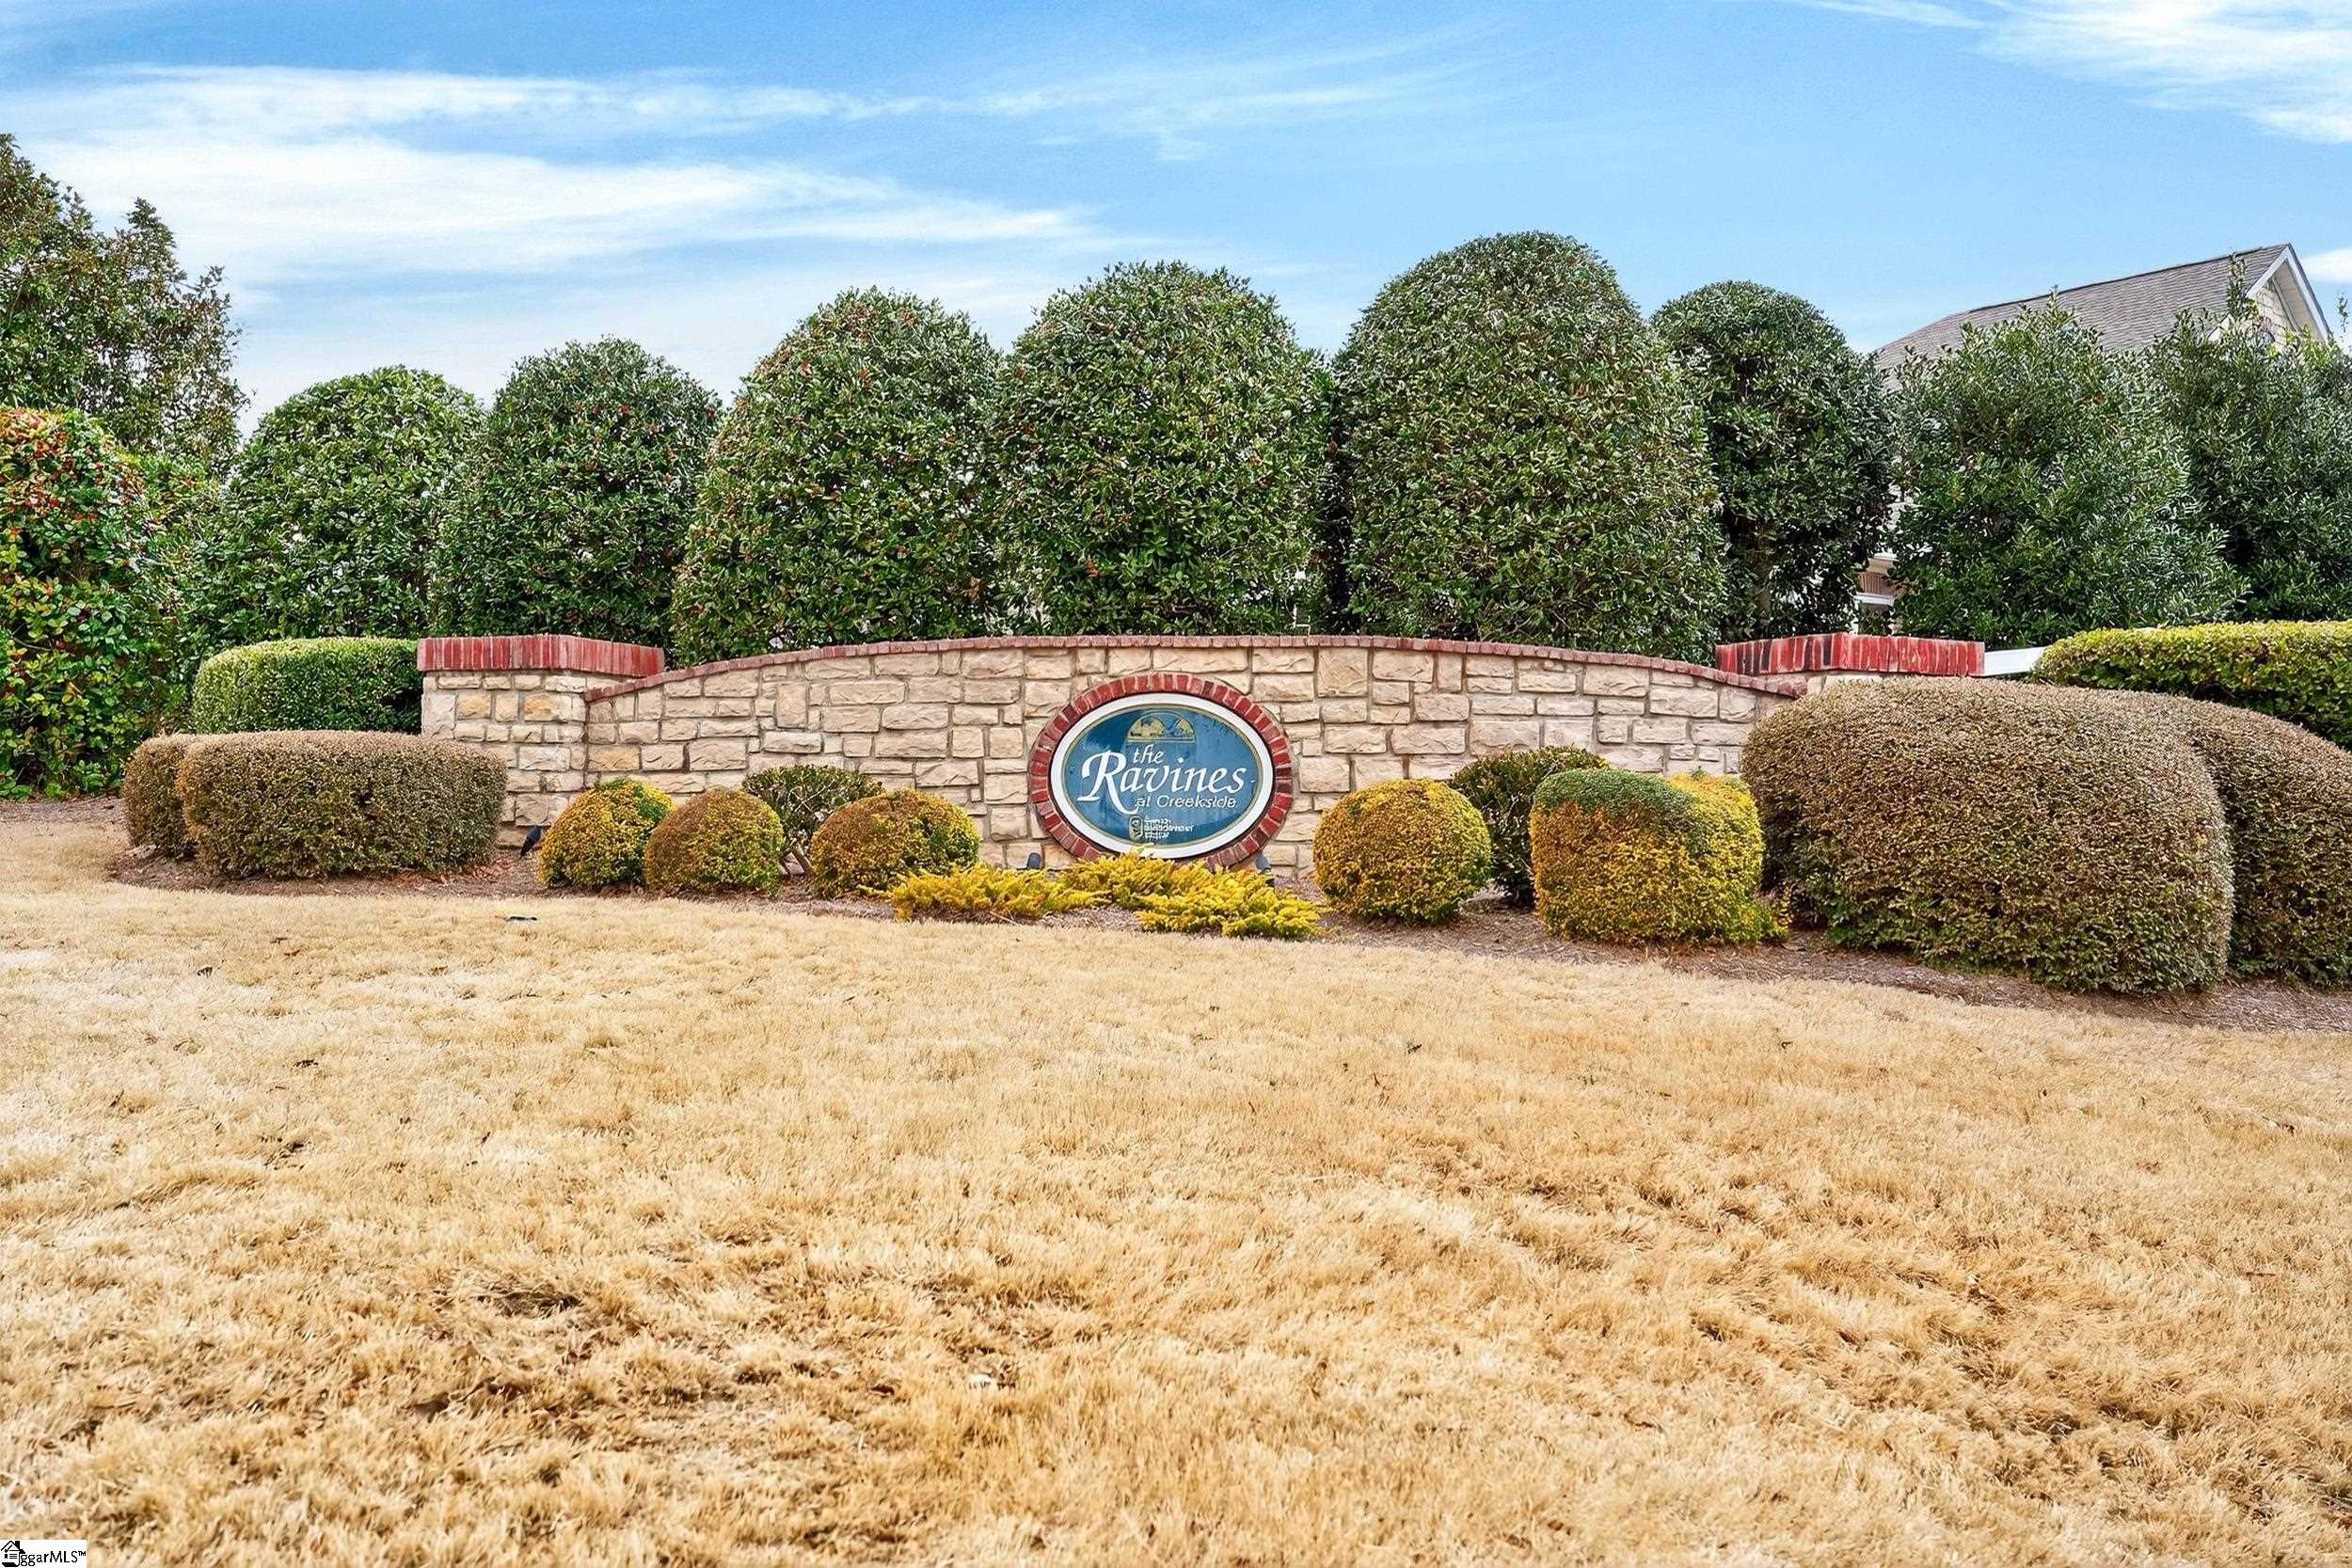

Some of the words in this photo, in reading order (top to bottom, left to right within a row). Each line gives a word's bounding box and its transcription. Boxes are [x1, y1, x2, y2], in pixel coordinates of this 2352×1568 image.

[1133, 744, 1164, 764] the
[1077, 751, 1247, 814] Ravines
[1136, 796, 1150, 809] at
[1157, 795, 1236, 808] Creekside
